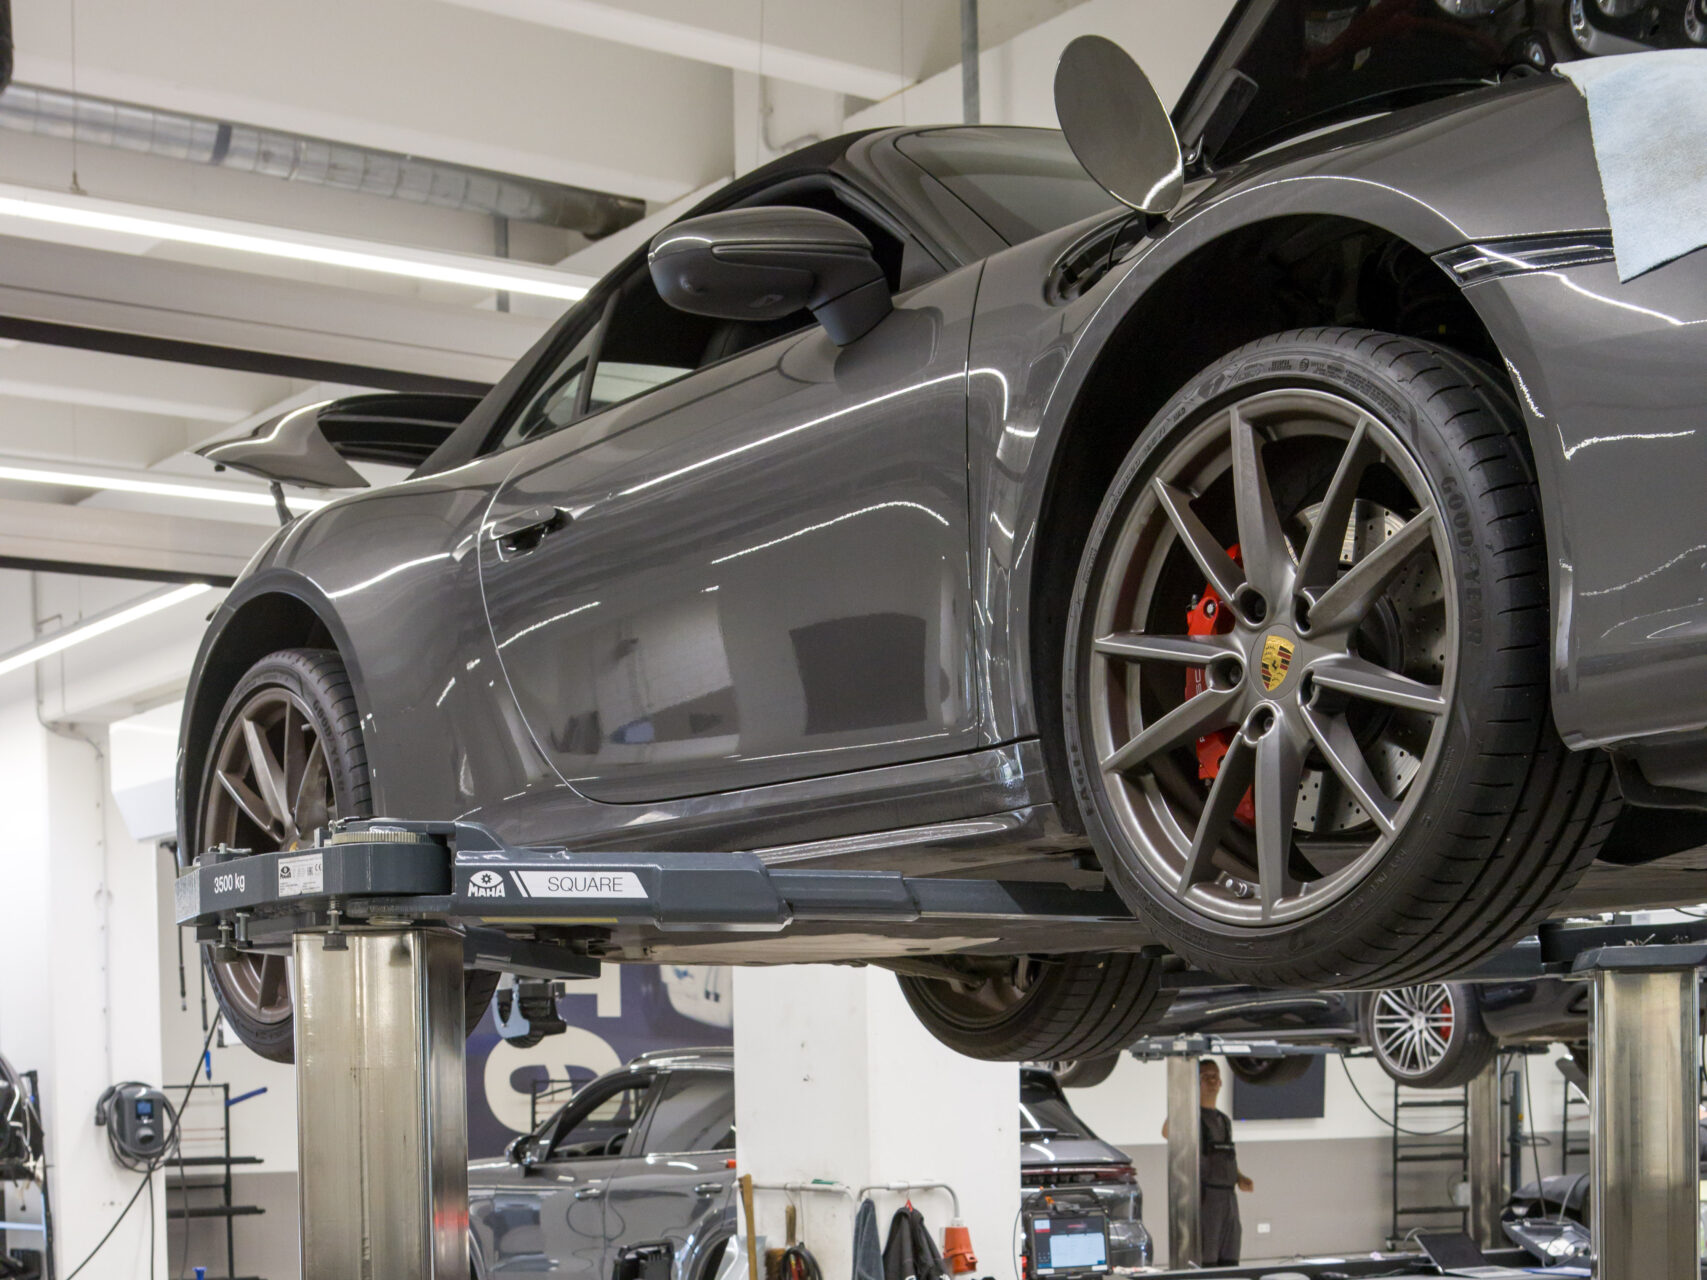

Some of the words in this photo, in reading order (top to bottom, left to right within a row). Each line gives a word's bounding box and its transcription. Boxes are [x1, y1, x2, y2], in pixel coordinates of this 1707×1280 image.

[214, 874, 232, 893] 3500
[235, 873, 245, 892] kg
[467, 882, 506, 897] MAHA
[547, 876, 623, 892] SQUARE
